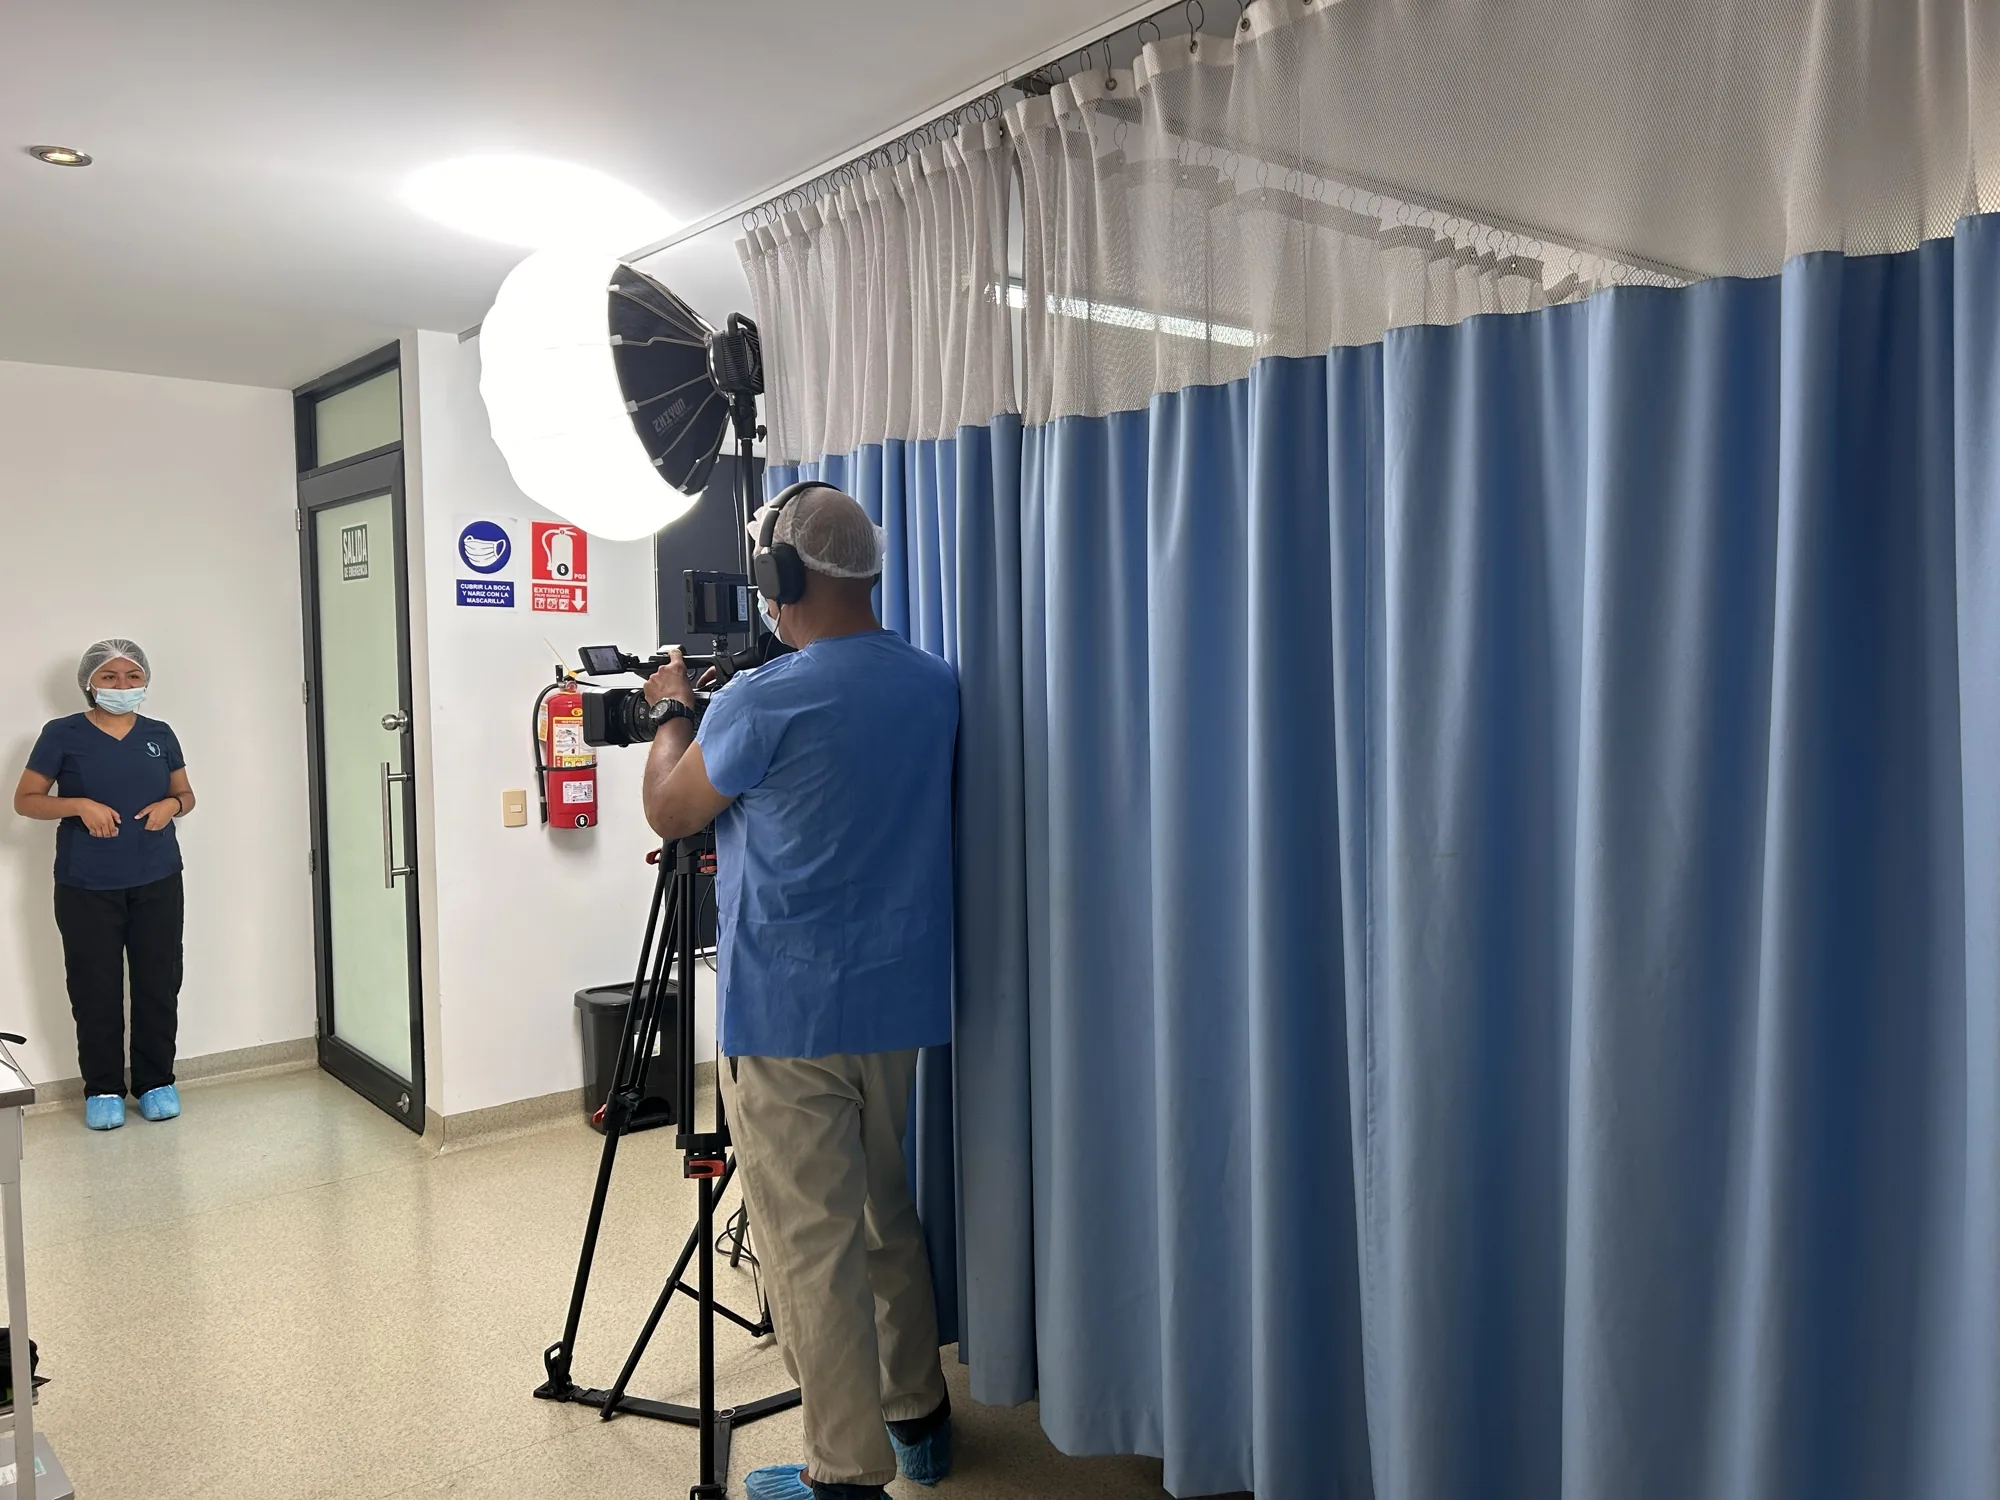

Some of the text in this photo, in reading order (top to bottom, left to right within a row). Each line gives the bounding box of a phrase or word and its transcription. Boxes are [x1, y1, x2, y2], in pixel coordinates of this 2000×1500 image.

[653, 398, 685, 432] ZHIYUN
[343, 528, 367, 565] SALIDA
[560, 565, 565, 573] 6
[466, 597, 505, 605] MASCARILLA
[580, 817, 585, 825] 6
